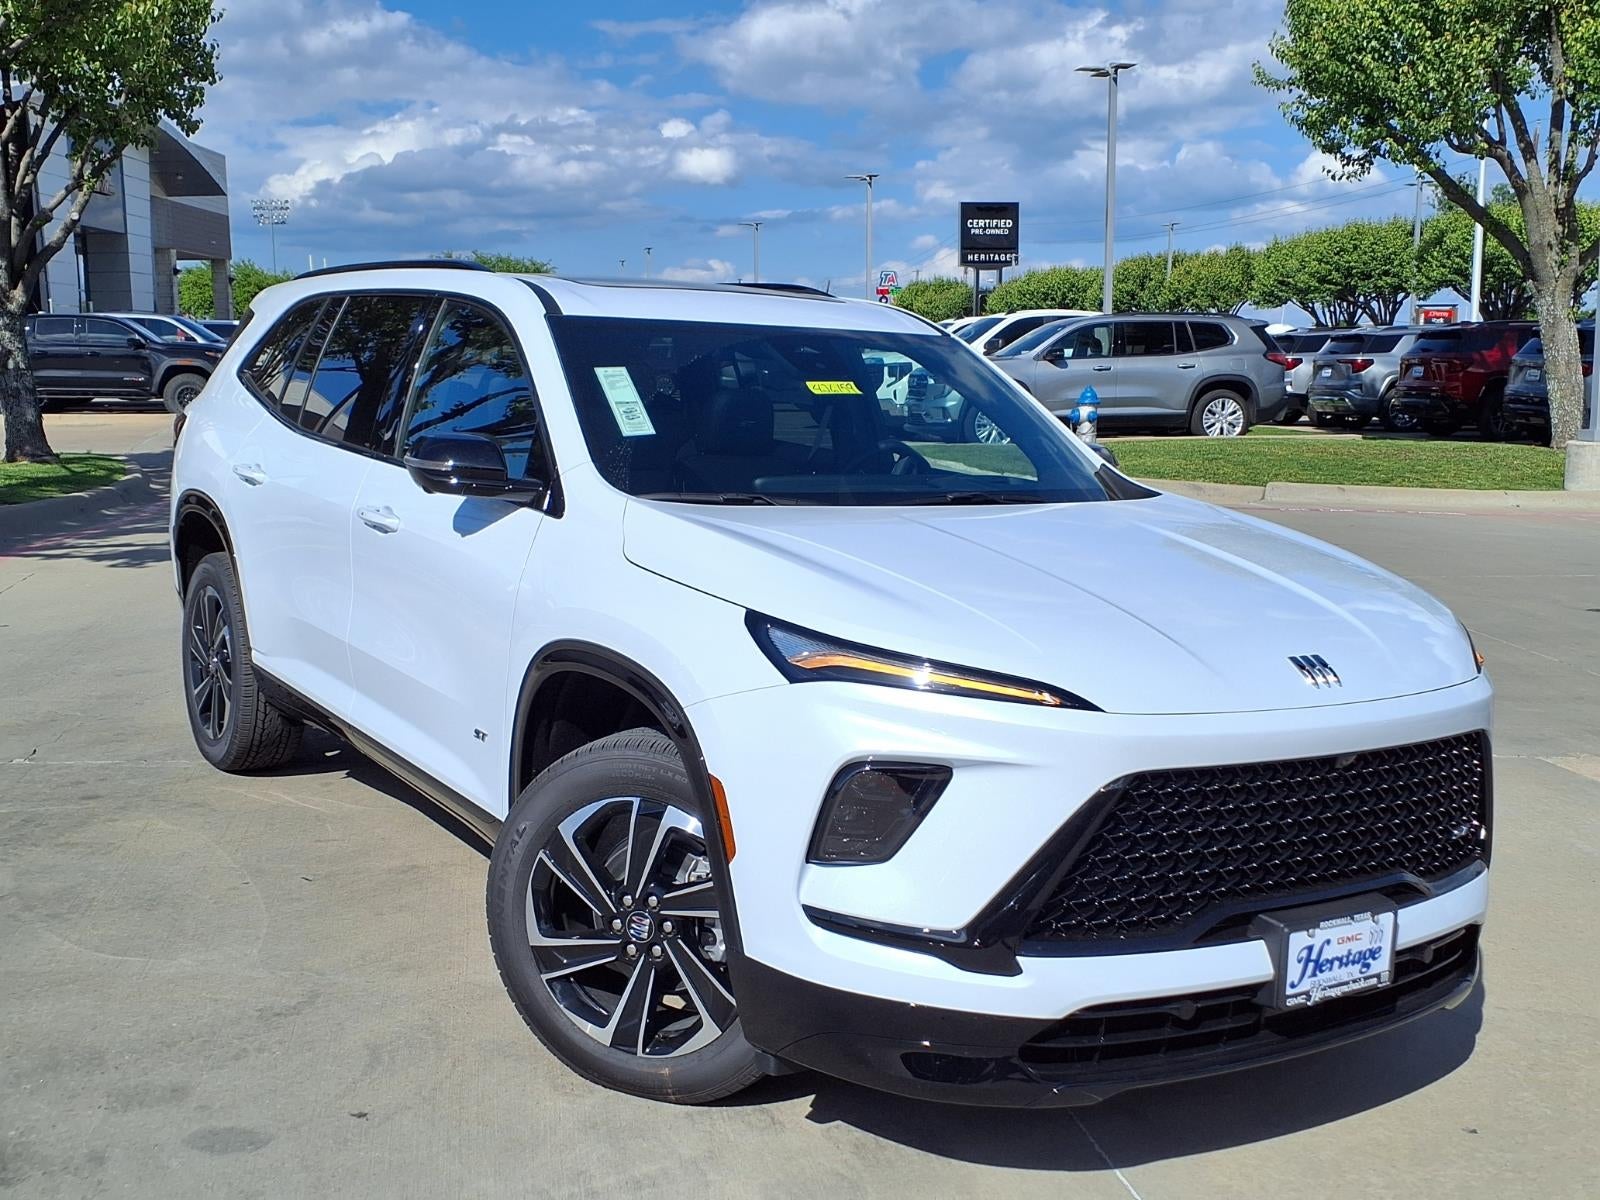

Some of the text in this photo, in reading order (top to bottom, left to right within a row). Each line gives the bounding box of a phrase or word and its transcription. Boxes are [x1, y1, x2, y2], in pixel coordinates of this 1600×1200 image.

[967, 219, 1013, 228] CERTIFIED
[967, 253, 1012, 261] HERITAGE
[880, 271, 898, 286] TA
[473, 728, 488, 743] ST
[1337, 933, 1363, 945] GMC
[1289, 938, 1382, 989] Heritage
[1286, 995, 1307, 1006] GMC
